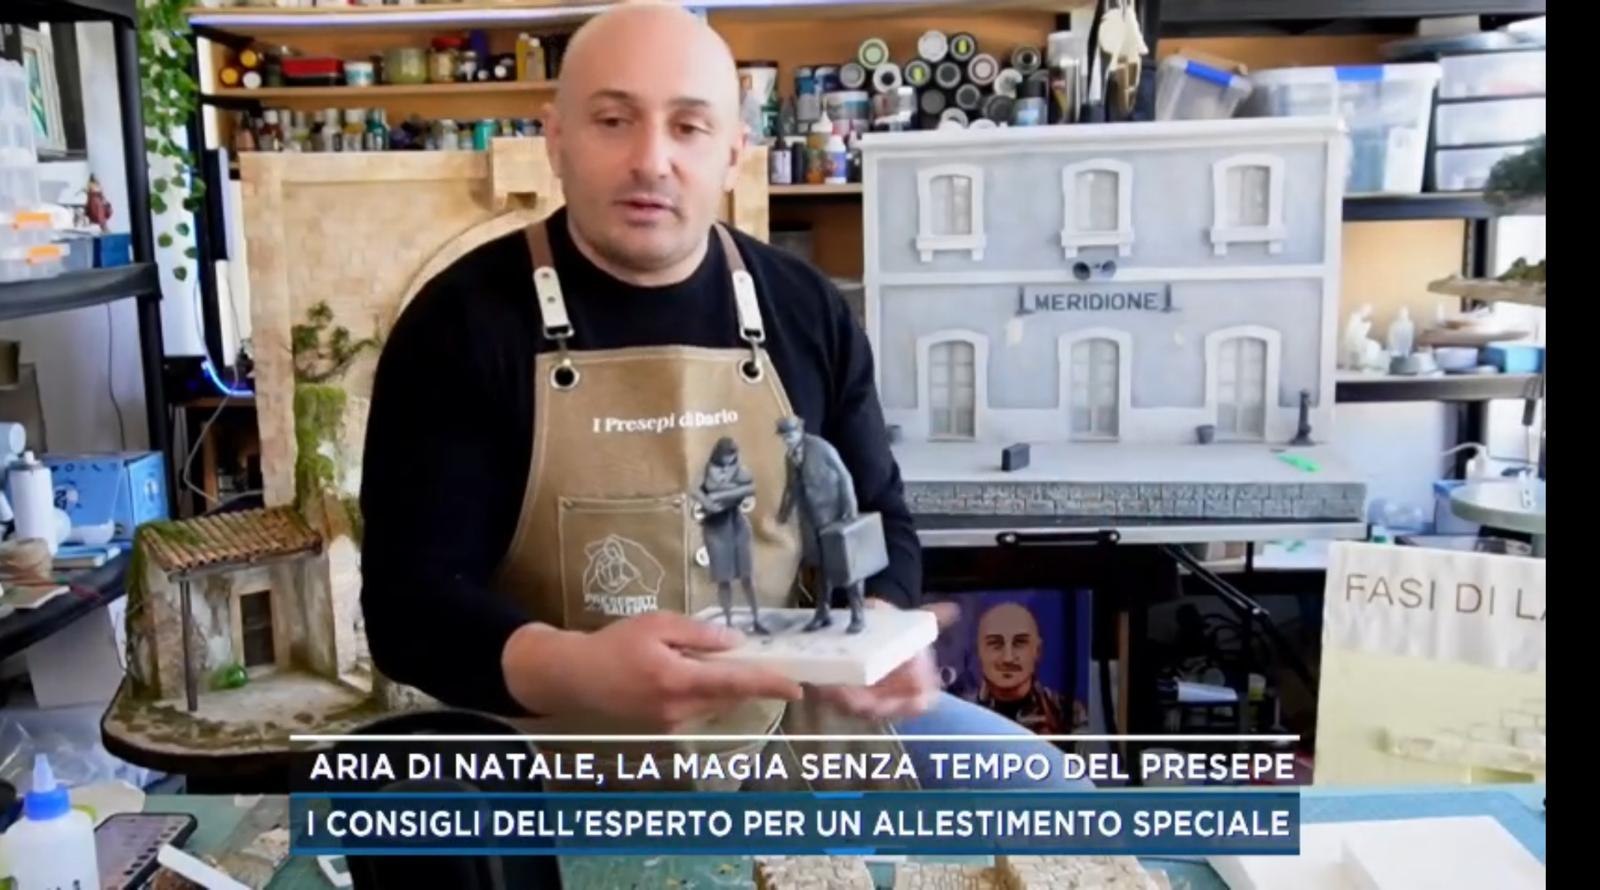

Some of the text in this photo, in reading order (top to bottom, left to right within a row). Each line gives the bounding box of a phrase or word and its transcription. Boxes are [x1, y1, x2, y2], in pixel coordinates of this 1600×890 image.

[1034, 292, 1160, 312] MERIDIONE
[605, 412, 675, 433] Presepi
[1345, 572, 1437, 612] FASI
[1455, 582, 1496, 616] DI
